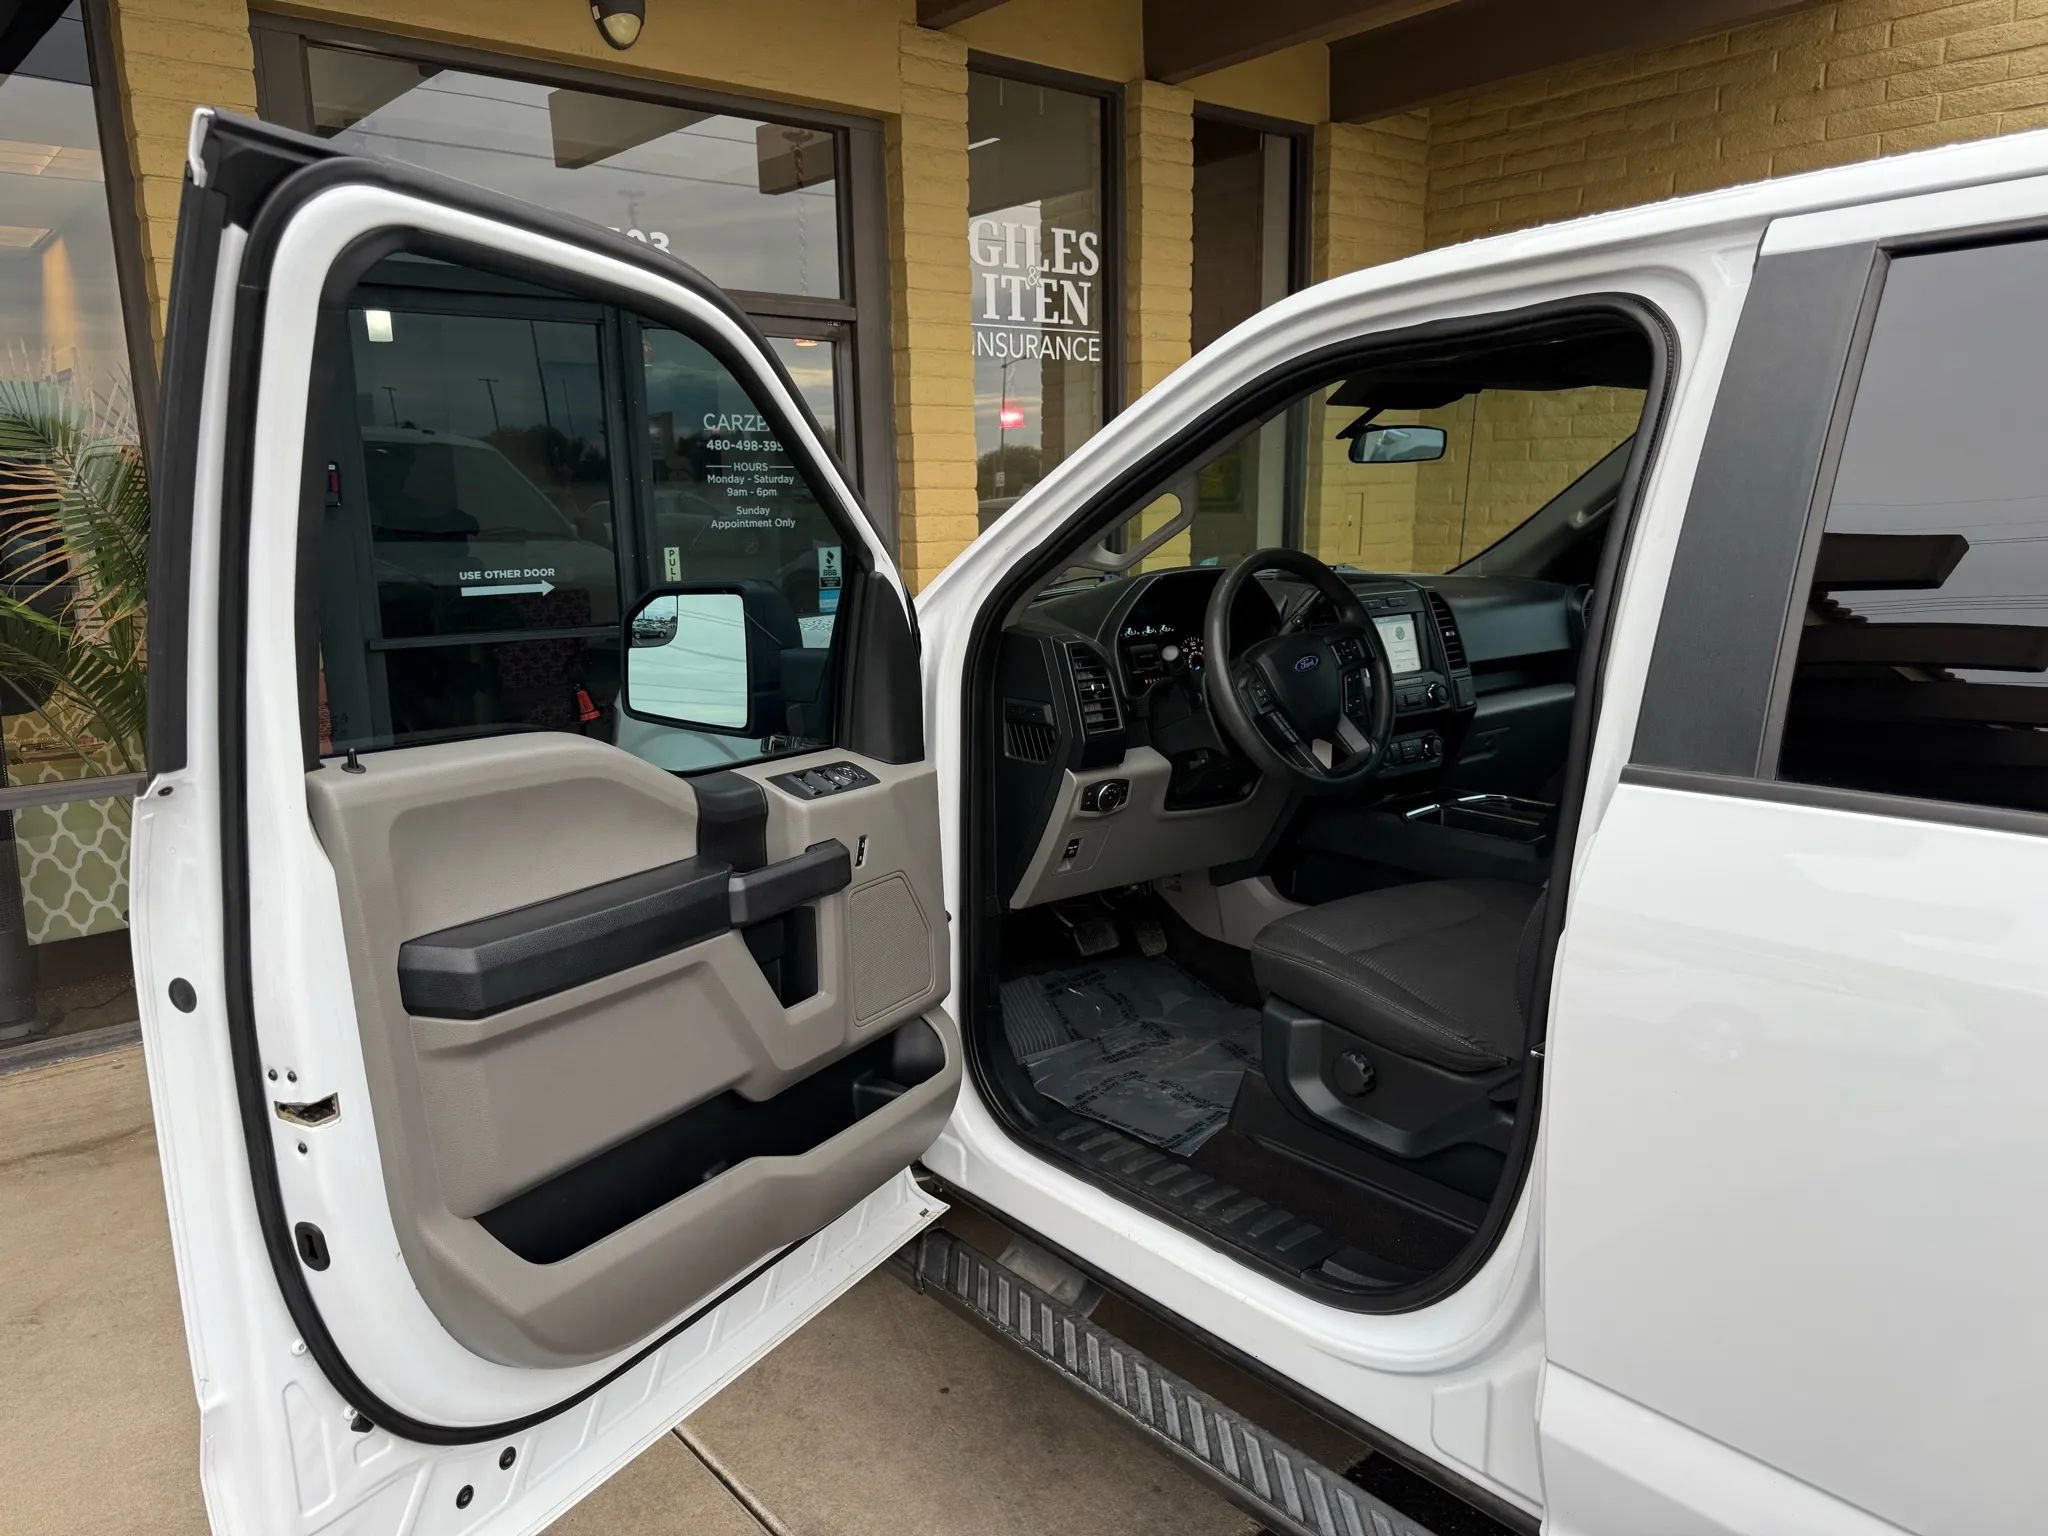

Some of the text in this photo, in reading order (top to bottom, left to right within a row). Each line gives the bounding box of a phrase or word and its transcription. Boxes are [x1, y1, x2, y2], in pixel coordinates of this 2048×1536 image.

[968, 219, 1099, 276] GILES
[1027, 264, 1042, 288] &
[982, 273, 1092, 326] ITEN
[703, 413, 770, 431] CARZE
[706, 439, 784, 452] 480-498-395
[733, 462, 769, 472] HOURS
[706, 474, 745, 485] Monday
[753, 474, 795, 485] Saturday
[726, 487, 748, 497] 9am
[756, 487, 778, 498] 6pm
[736, 505, 771, 516] Sunday
[710, 518, 796, 530] Appointment Only
[459, 568, 556, 580] USE OTHER DOOR
